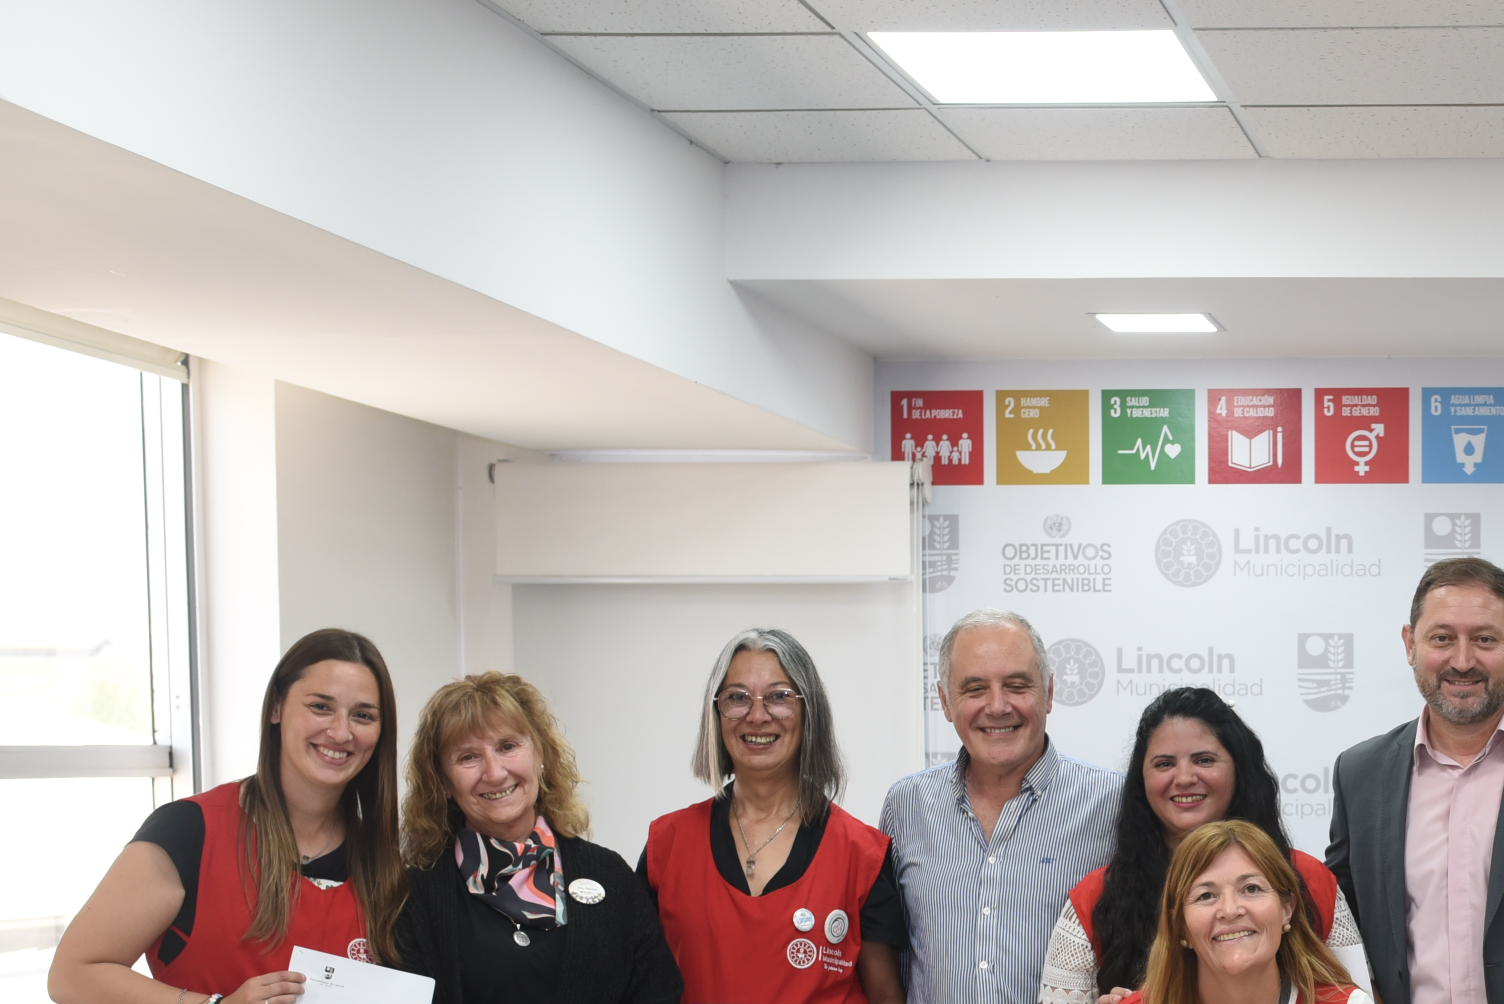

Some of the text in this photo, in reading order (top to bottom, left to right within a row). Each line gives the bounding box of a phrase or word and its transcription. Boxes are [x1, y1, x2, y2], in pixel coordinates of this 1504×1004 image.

[912, 397, 923, 407] FIN
[1020, 397, 1050, 407] HAMBRE
[1126, 397, 1150, 406] SALUD
[1342, 395, 1377, 405] IGUALDAD
[1430, 395, 1442, 416] 6
[1450, 394, 1494, 404] AGUA LIMPIA
[901, 398, 908, 419] 1
[1005, 397, 1015, 418] 2
[1110, 397, 1121, 417] 3
[1126, 408, 1169, 417] Y BIENESTAR
[1216, 396, 1227, 417] 4
[1234, 408, 1274, 417] DE CALIDAD
[1324, 396, 1334, 416] 5
[1342, 406, 1350, 416] DE
[1450, 406, 1504, 416] Y SANEAMIENTO
[912, 409, 963, 419] DE LA POBREZA
[1020, 409, 1040, 418] CERO
[1233, 526, 1354, 555] Lincoln
[1001, 543, 1112, 561] OBJETIVOS
[1003, 563, 1112, 576] DE DESARROLLO
[1233, 559, 1382, 581] Municipalidad
[1002, 578, 1112, 593] SOSTENIBLE
[1116, 646, 1235, 674] Lincoln
